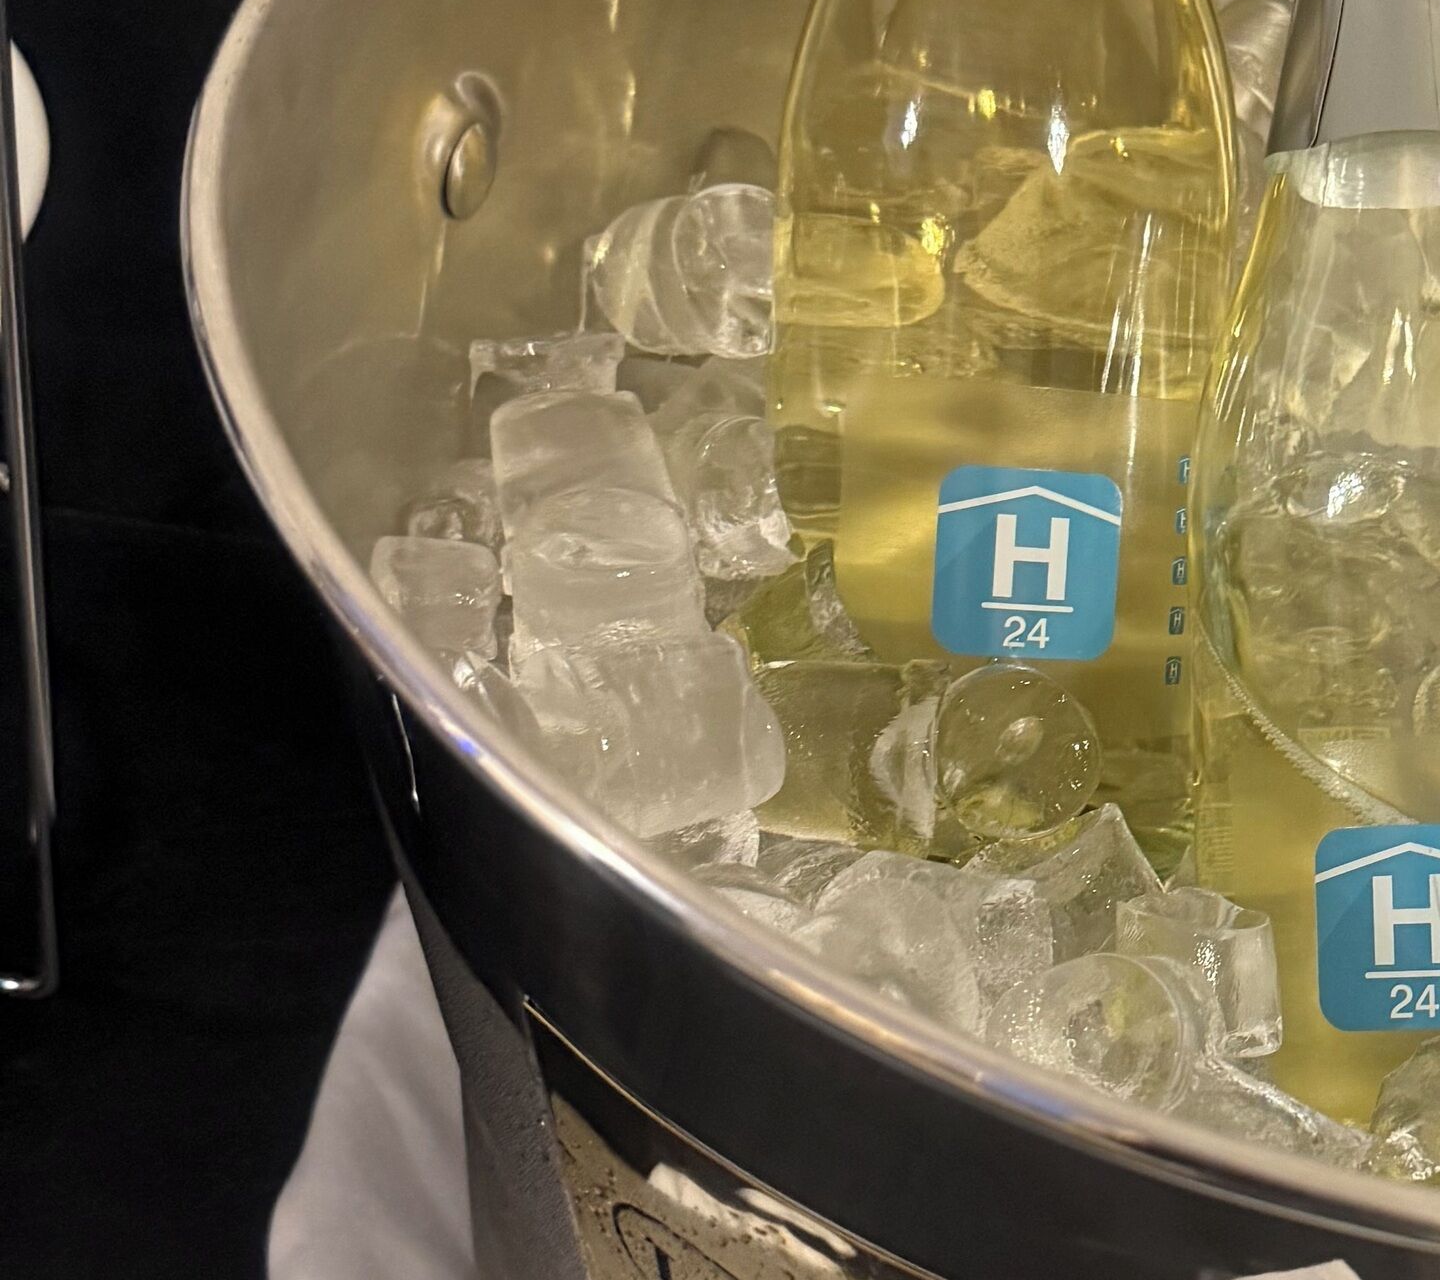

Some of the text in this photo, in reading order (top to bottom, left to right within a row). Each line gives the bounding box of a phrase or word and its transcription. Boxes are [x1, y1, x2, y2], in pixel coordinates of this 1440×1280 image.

[992, 513, 1070, 601] H
[1002, 615, 1050, 650] 24
[1389, 984, 1440, 1019] 24
